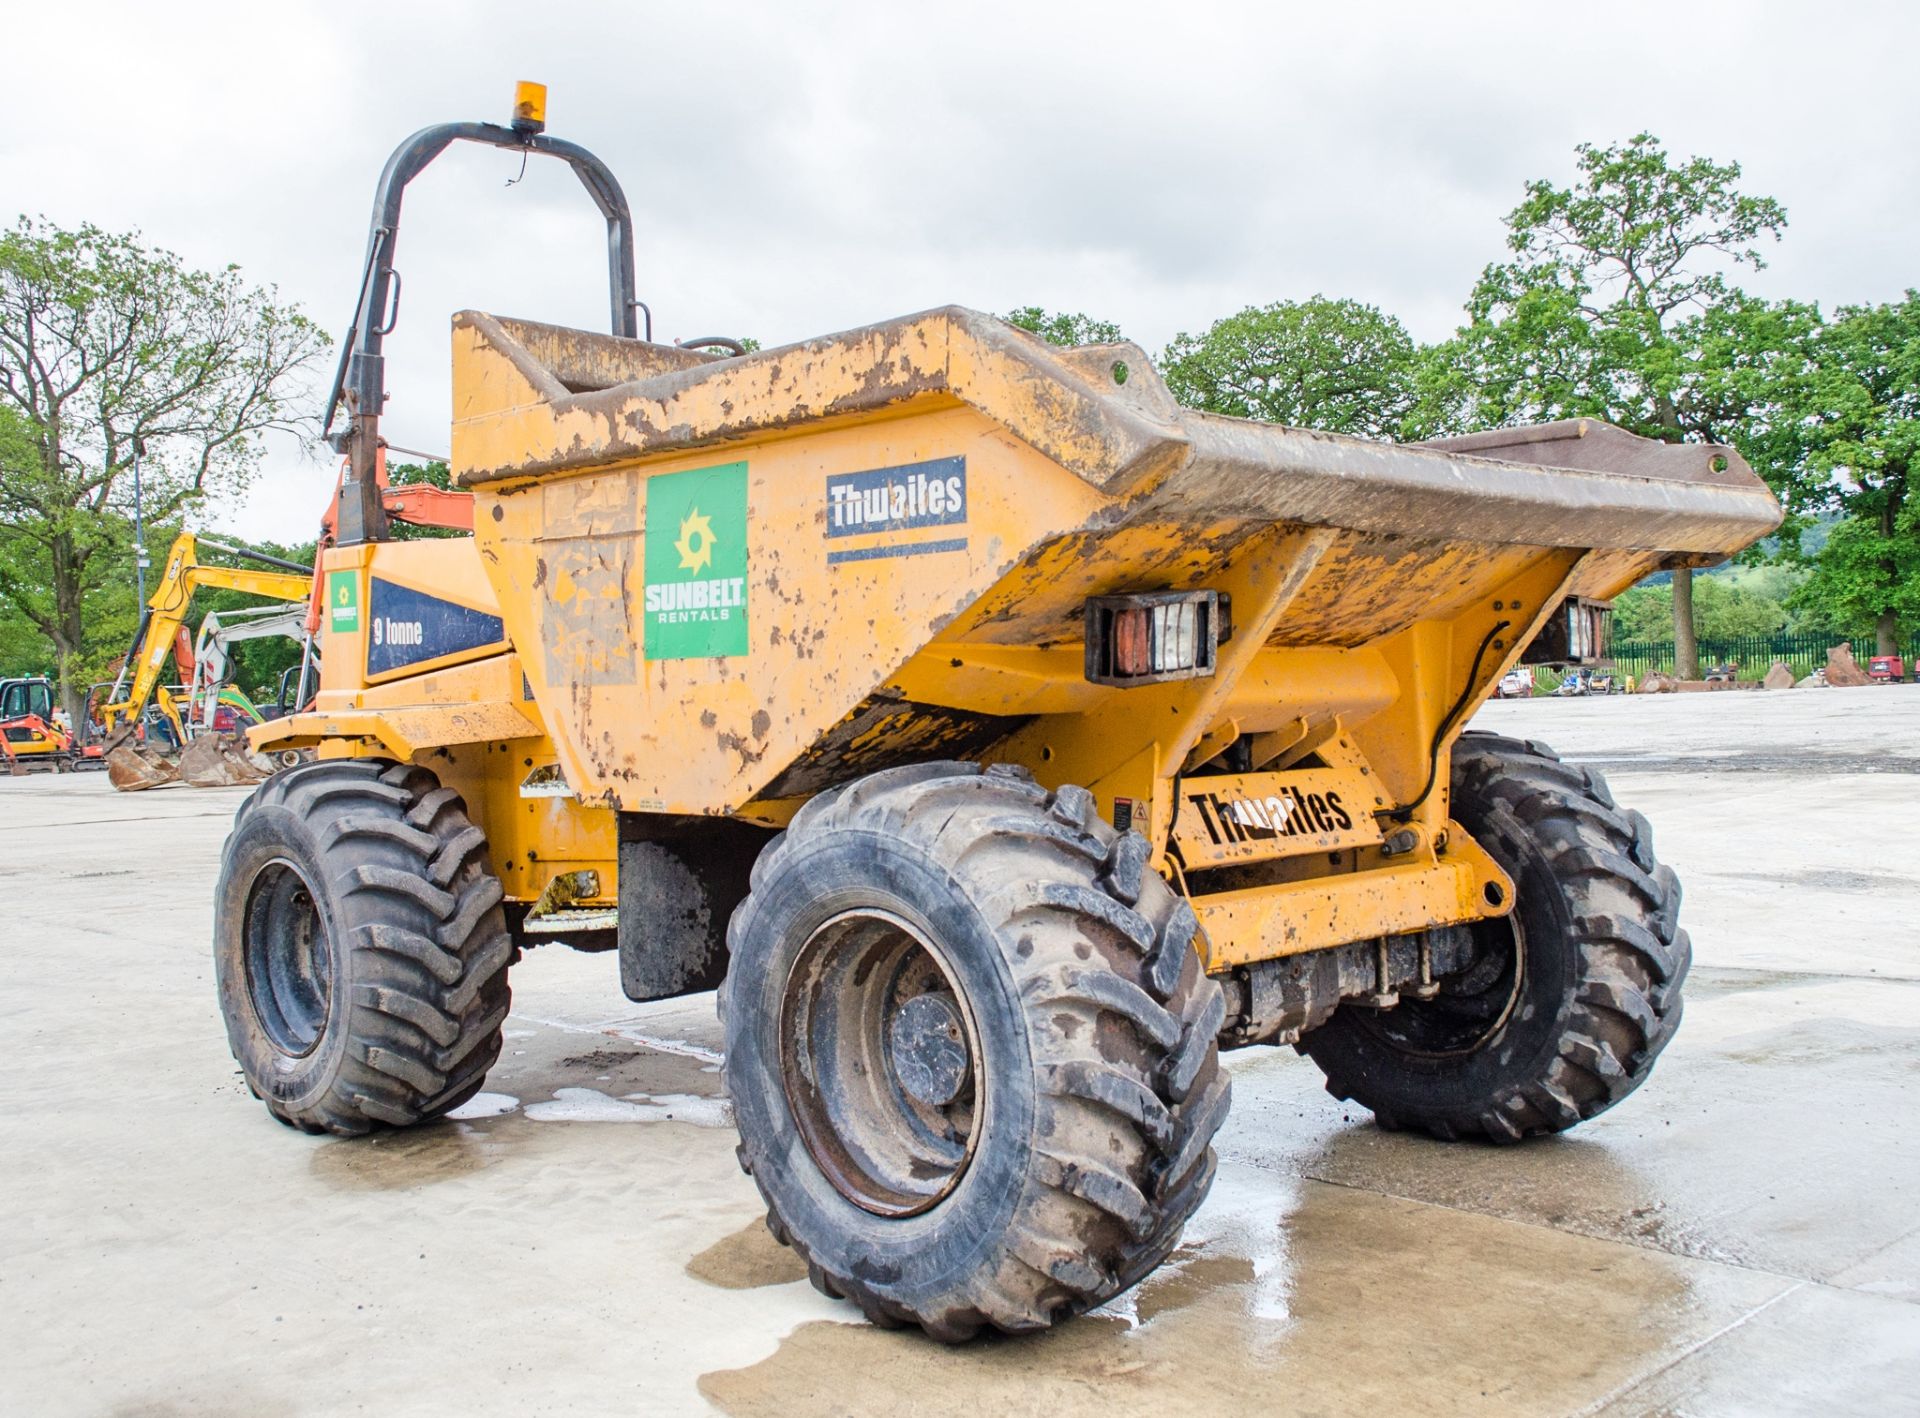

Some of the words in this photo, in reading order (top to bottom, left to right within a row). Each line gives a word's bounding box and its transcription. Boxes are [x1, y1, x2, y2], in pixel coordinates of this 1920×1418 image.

[831, 473, 962, 526] Thwaites
[645, 577, 744, 612] SUNBELT
[373, 617, 383, 646] 9
[386, 617, 423, 646] tonne
[658, 608, 730, 624] RENTALS
[1187, 786, 1352, 844] Thwaites
